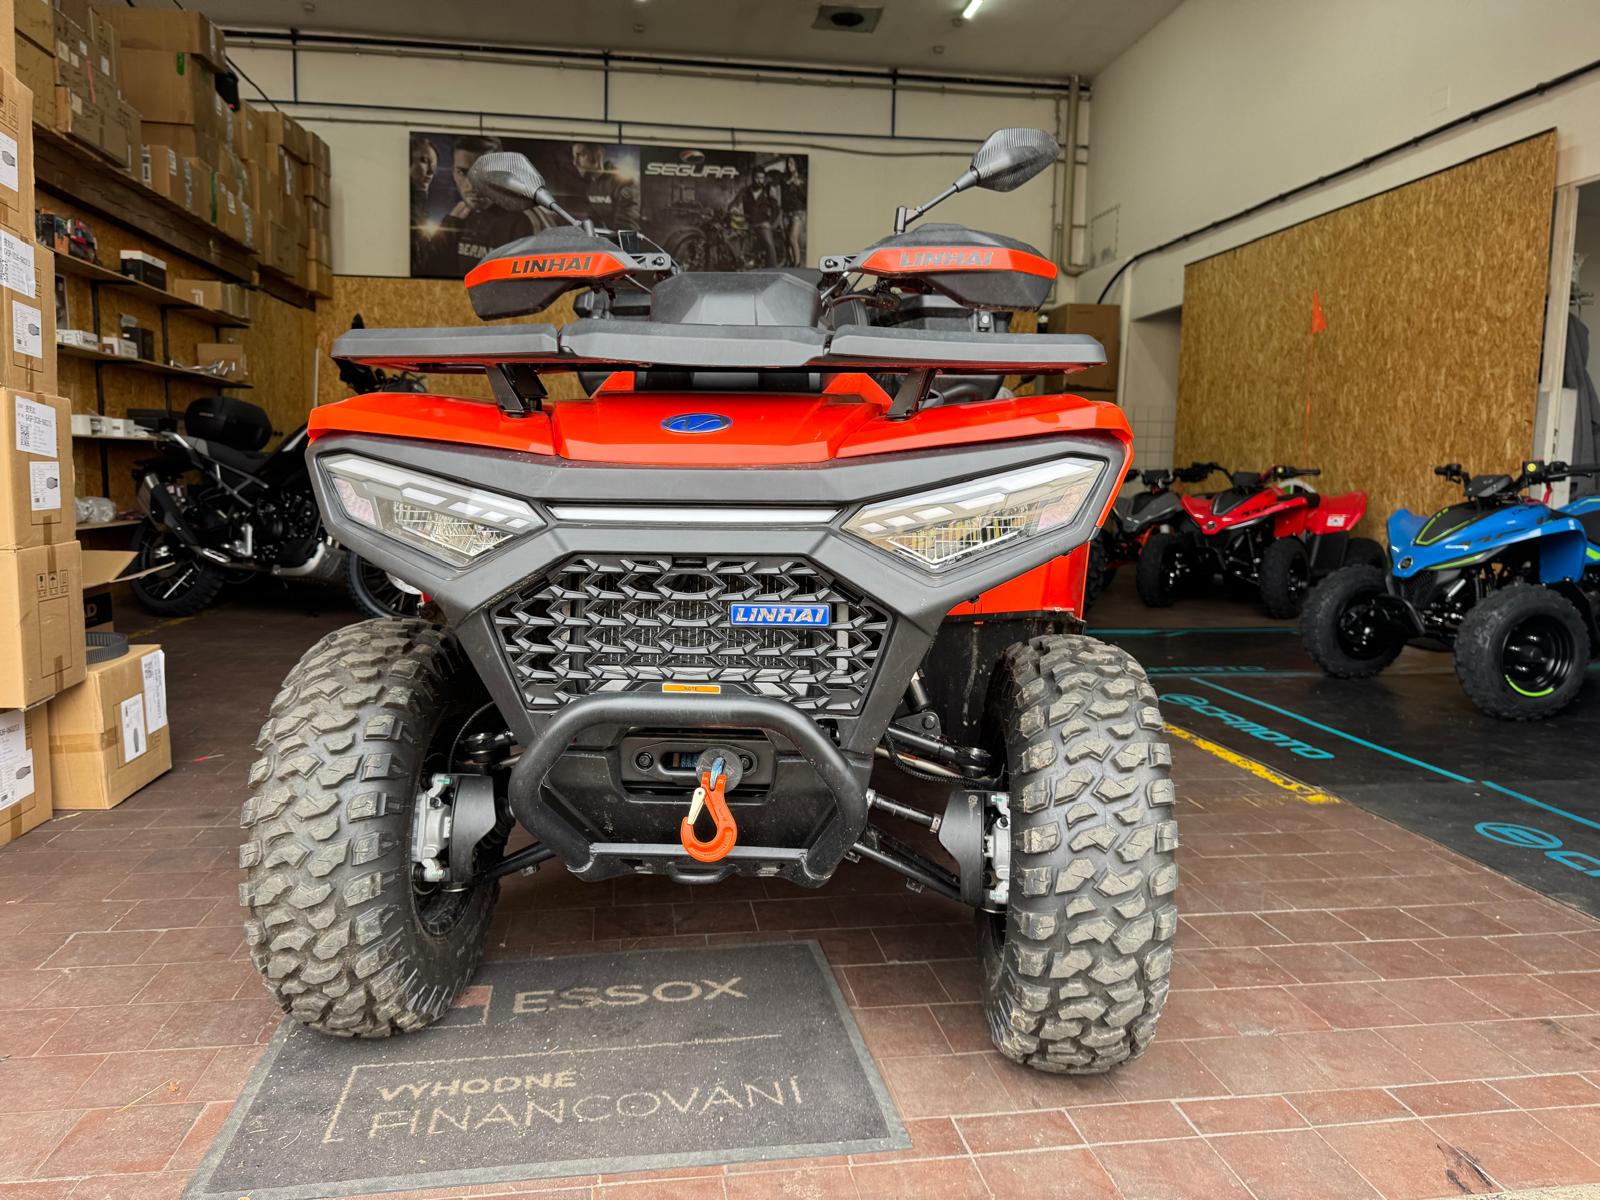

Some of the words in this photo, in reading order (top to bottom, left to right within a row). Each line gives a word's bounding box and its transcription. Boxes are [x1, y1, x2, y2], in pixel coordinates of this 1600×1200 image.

[645, 162, 740, 179] SEGURA
[511, 255, 593, 275] LINHAI
[900, 251, 994, 267] LINHAI
[735, 607, 825, 623] LINHAI
[512, 976, 748, 1014] ESSOX
